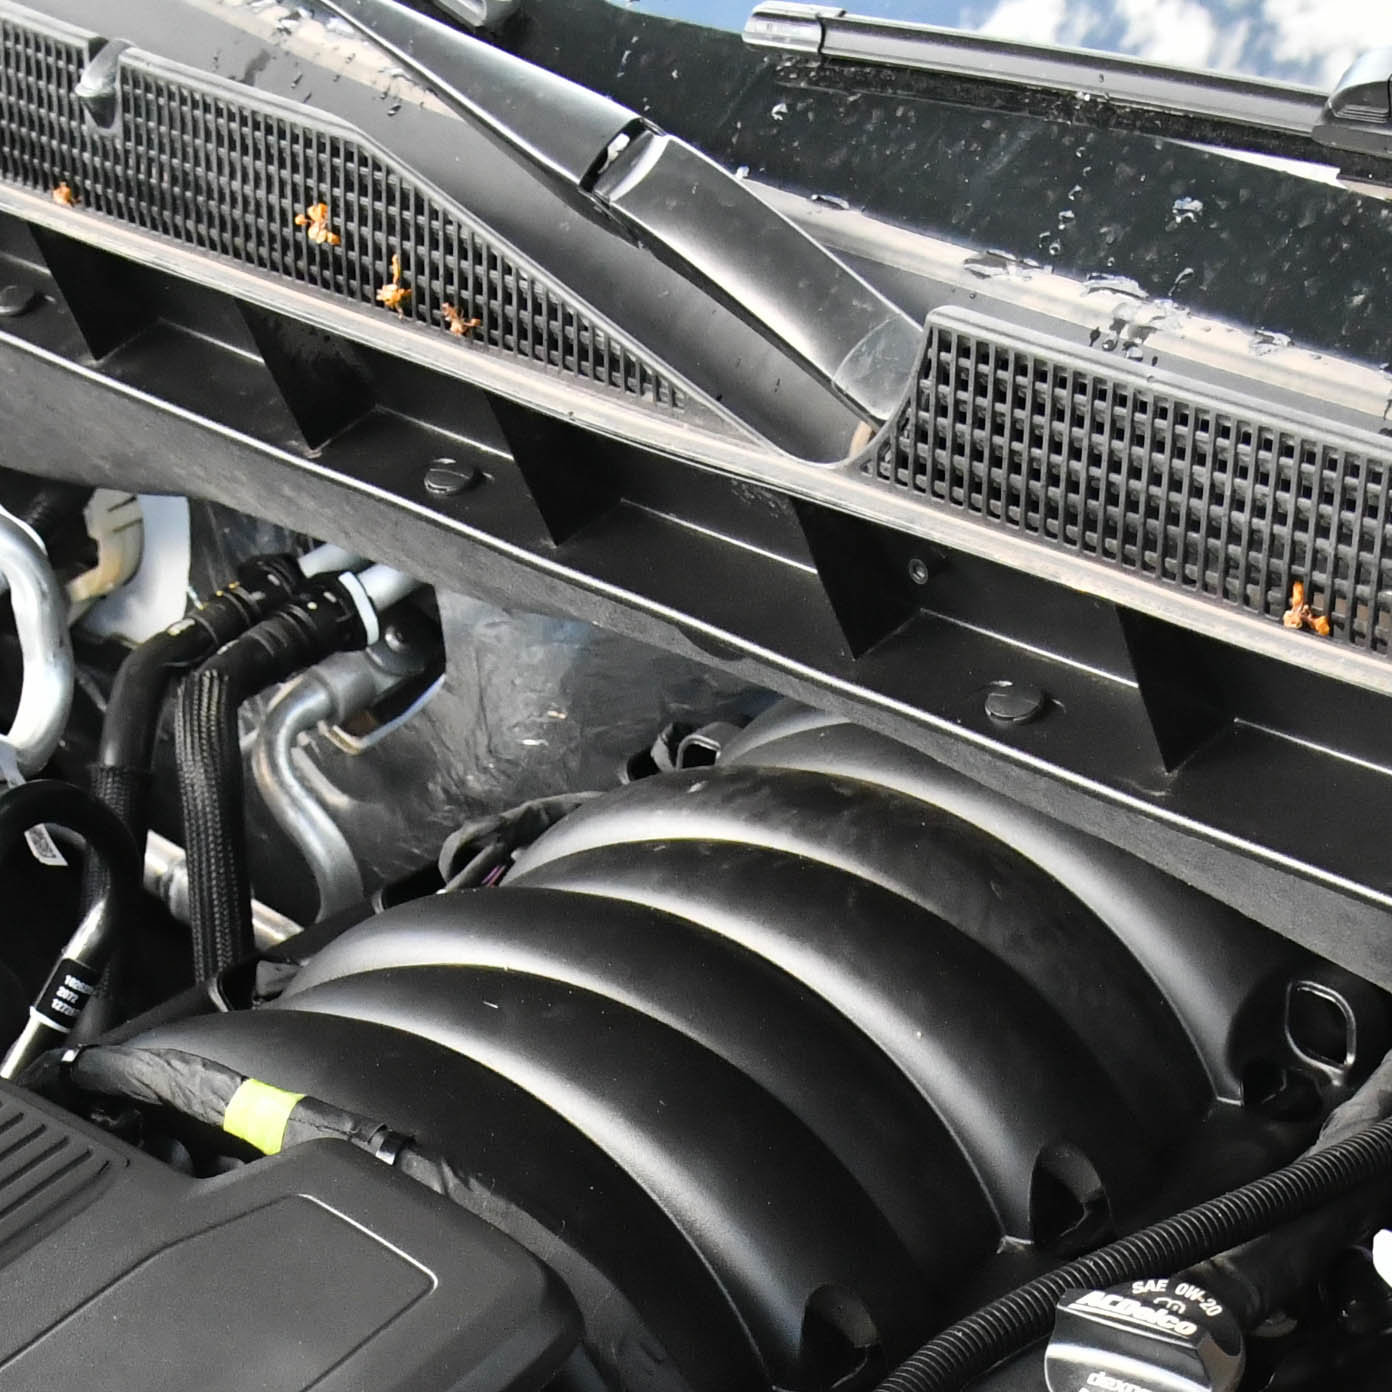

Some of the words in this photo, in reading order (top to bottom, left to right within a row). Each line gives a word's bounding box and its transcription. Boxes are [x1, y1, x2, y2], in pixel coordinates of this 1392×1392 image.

[1073, 1290, 1198, 1336] ACDelco
[1131, 1279, 1169, 1294] SAE
[1174, 1282, 1223, 1317] 0W-20
